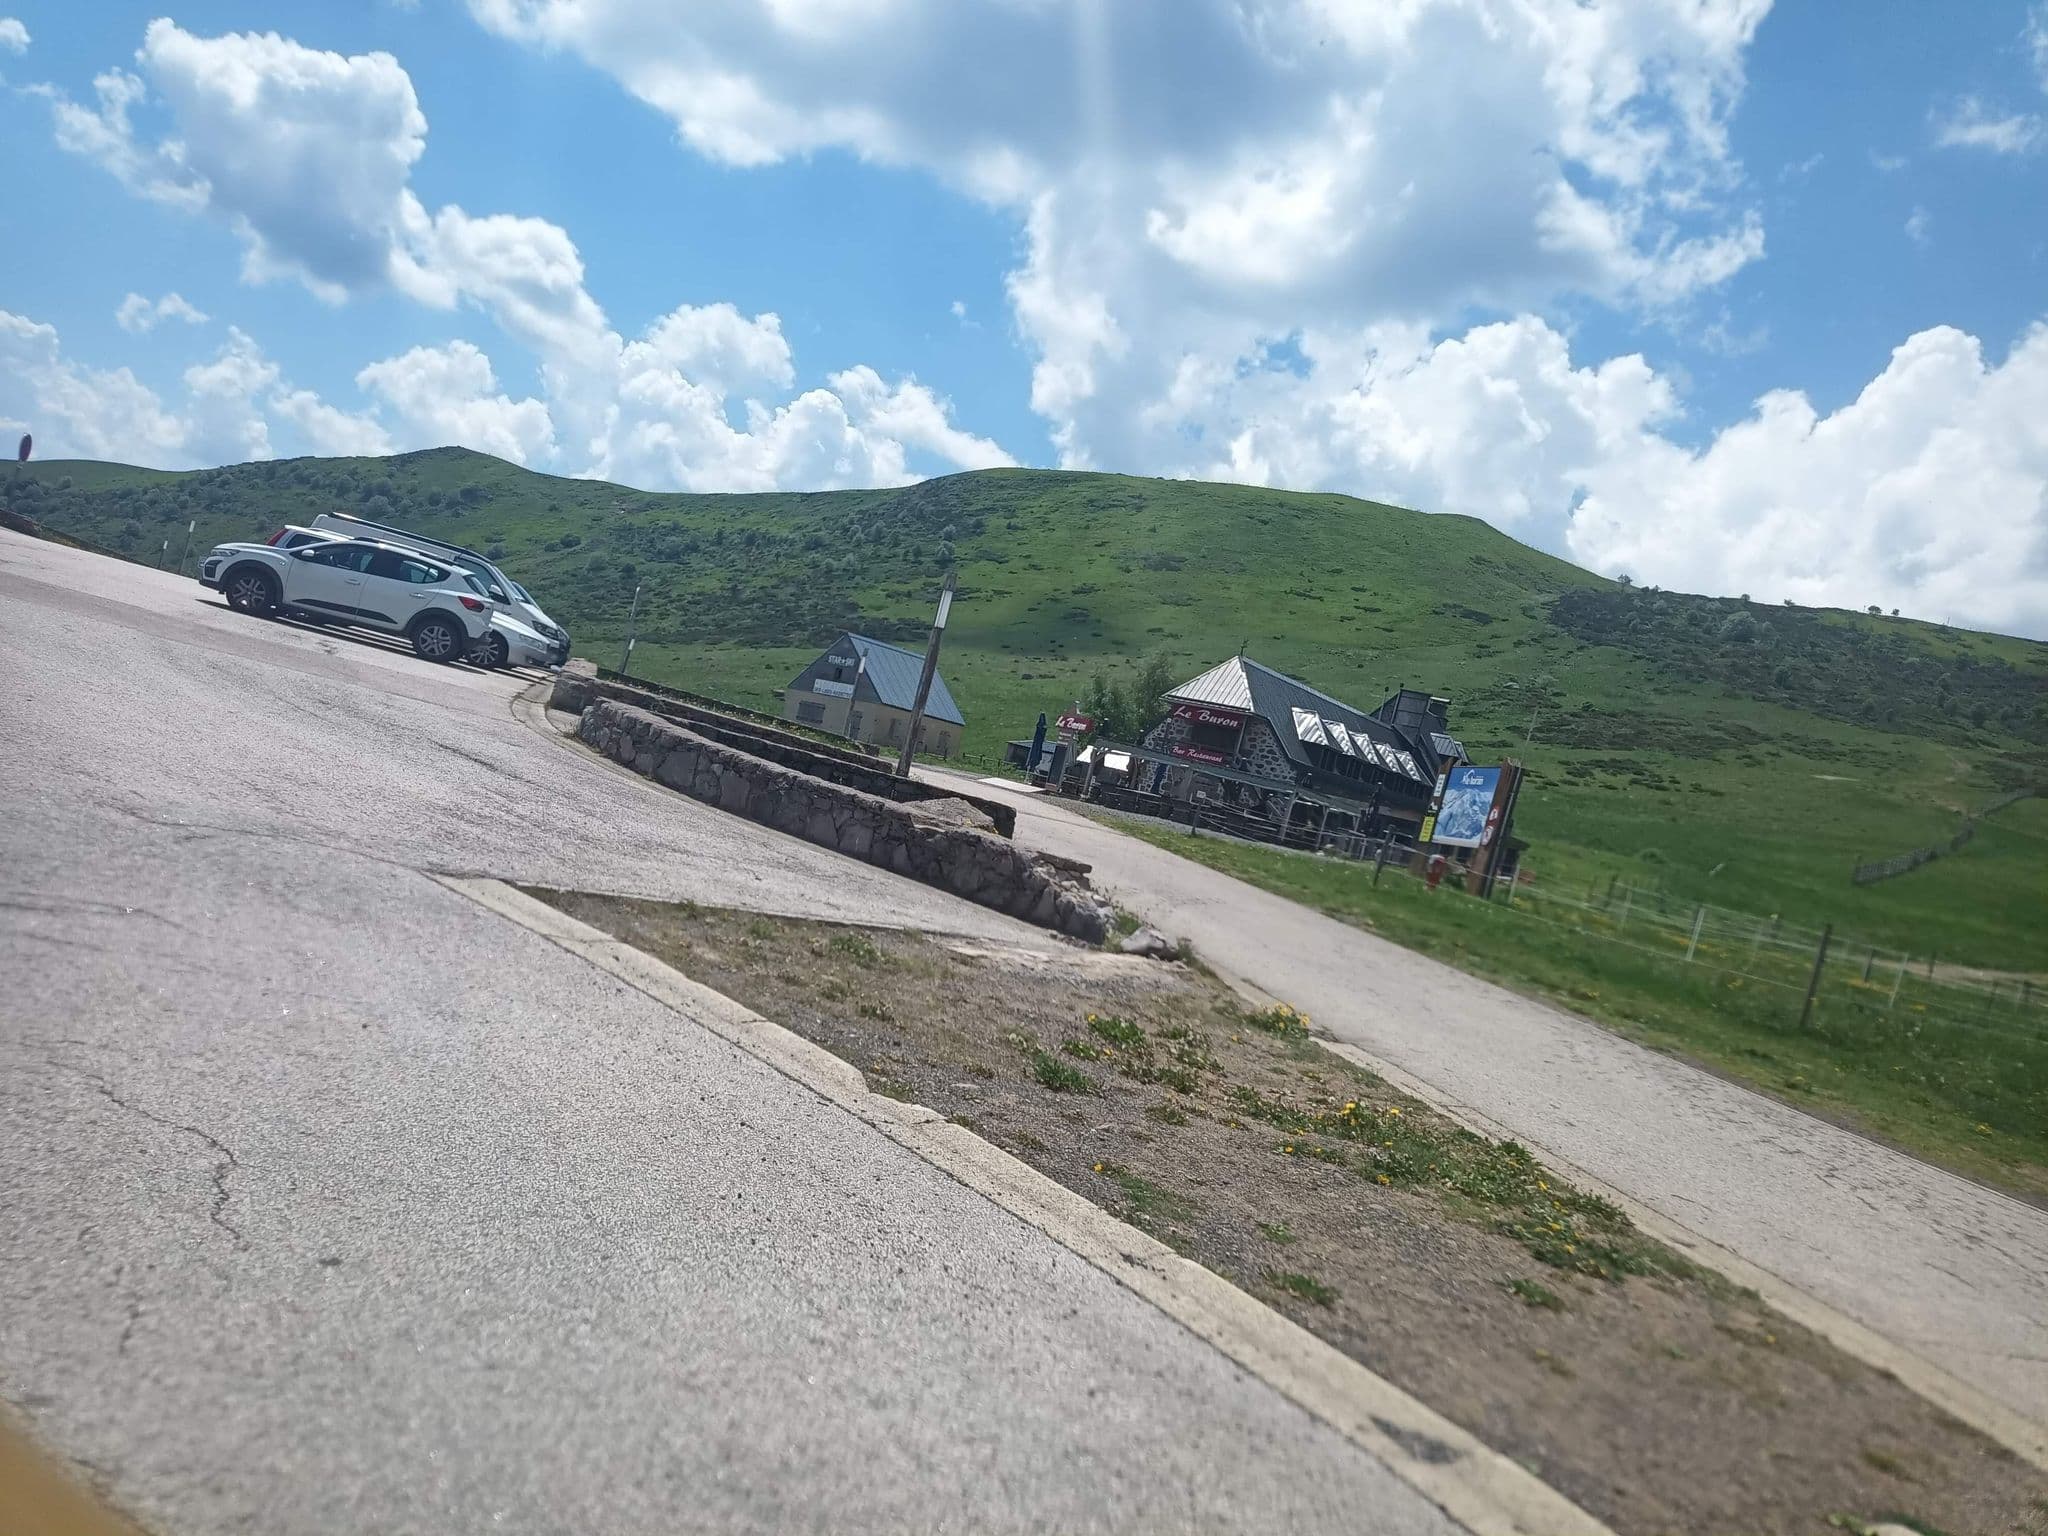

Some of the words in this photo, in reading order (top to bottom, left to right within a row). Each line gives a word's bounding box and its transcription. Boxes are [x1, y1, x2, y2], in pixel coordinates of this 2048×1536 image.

[1055, 716, 1066, 727] Le
[1066, 717, 1087, 731] Buron
[1173, 705, 1192, 719] Le
[1197, 709, 1239, 728] Buron
[1171, 746, 1185, 755] Bar
[1186, 748, 1223, 763] Restaurant
